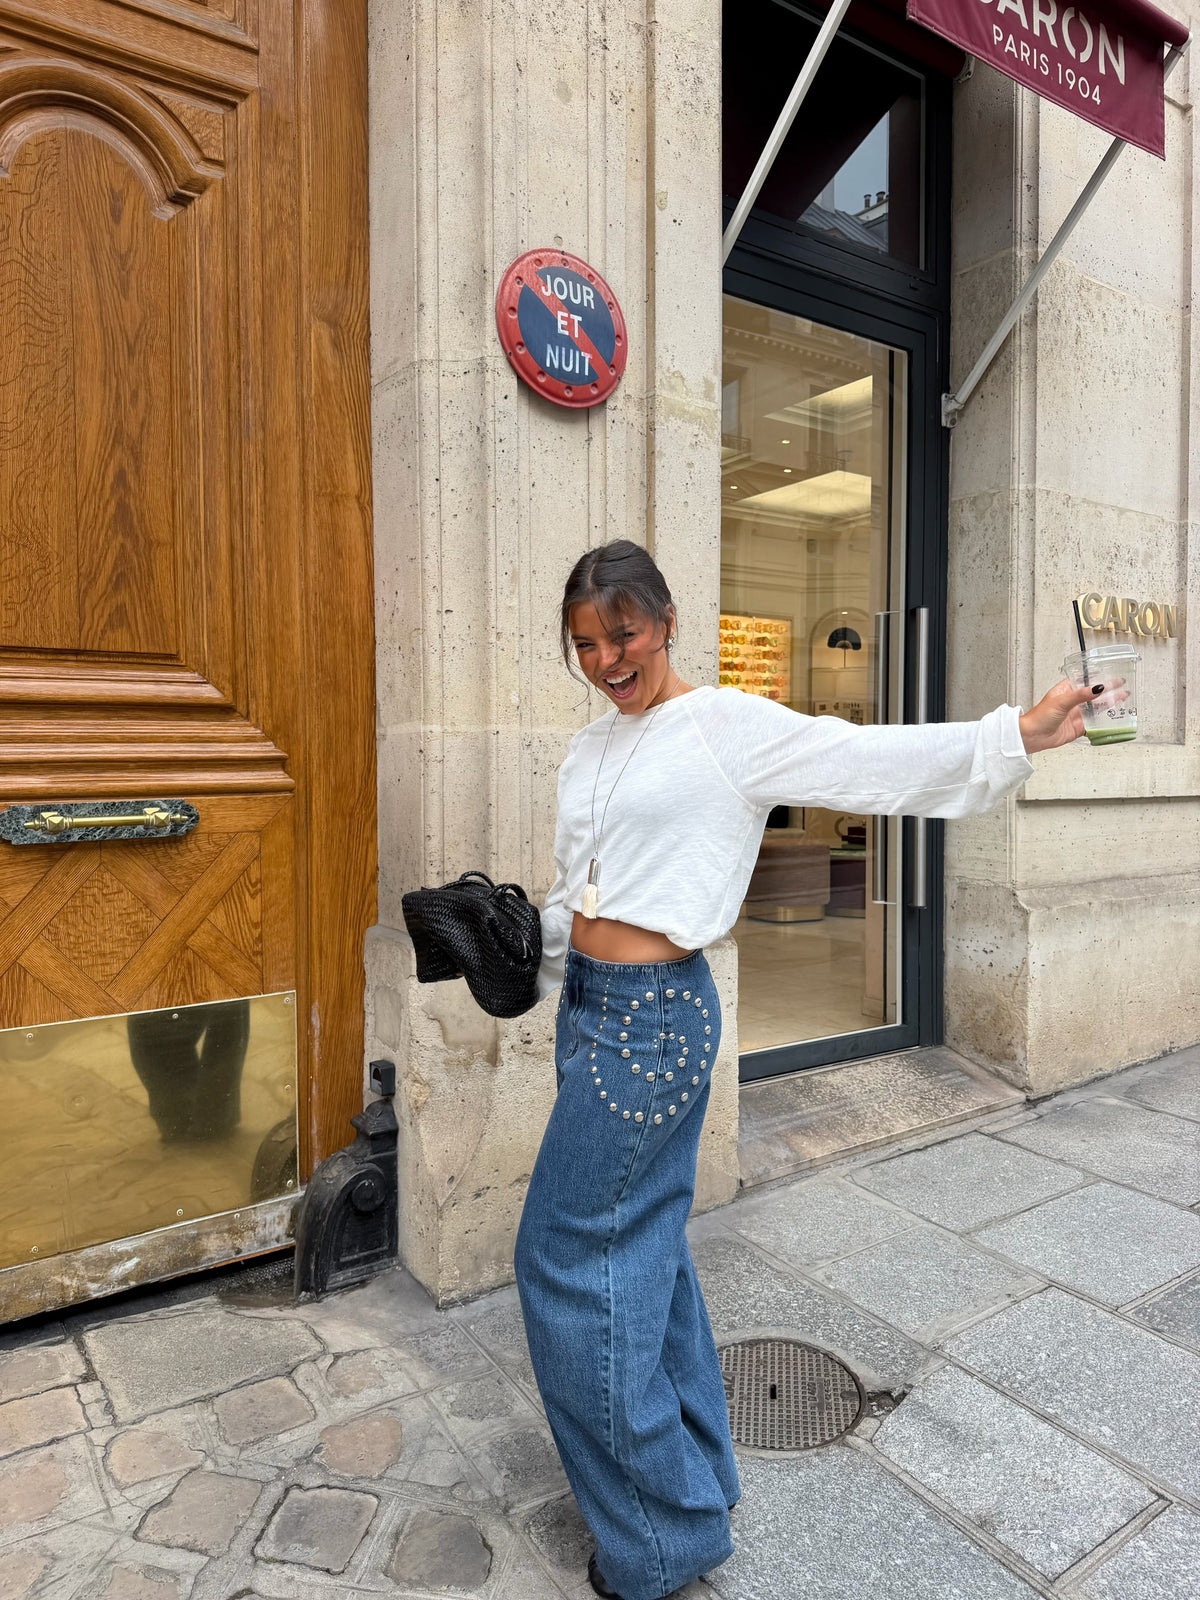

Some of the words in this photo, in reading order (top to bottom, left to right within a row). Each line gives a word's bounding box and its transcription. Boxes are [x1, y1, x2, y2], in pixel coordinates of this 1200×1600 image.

[980, 0, 1125, 85] ARON
[993, 24, 1050, 76] PARIS
[1057, 62, 1101, 105] 1904
[541, 274, 595, 309] JOUR
[557, 310, 583, 338] ET
[545, 343, 593, 376] NUIT
[1079, 592, 1177, 638] CARON
